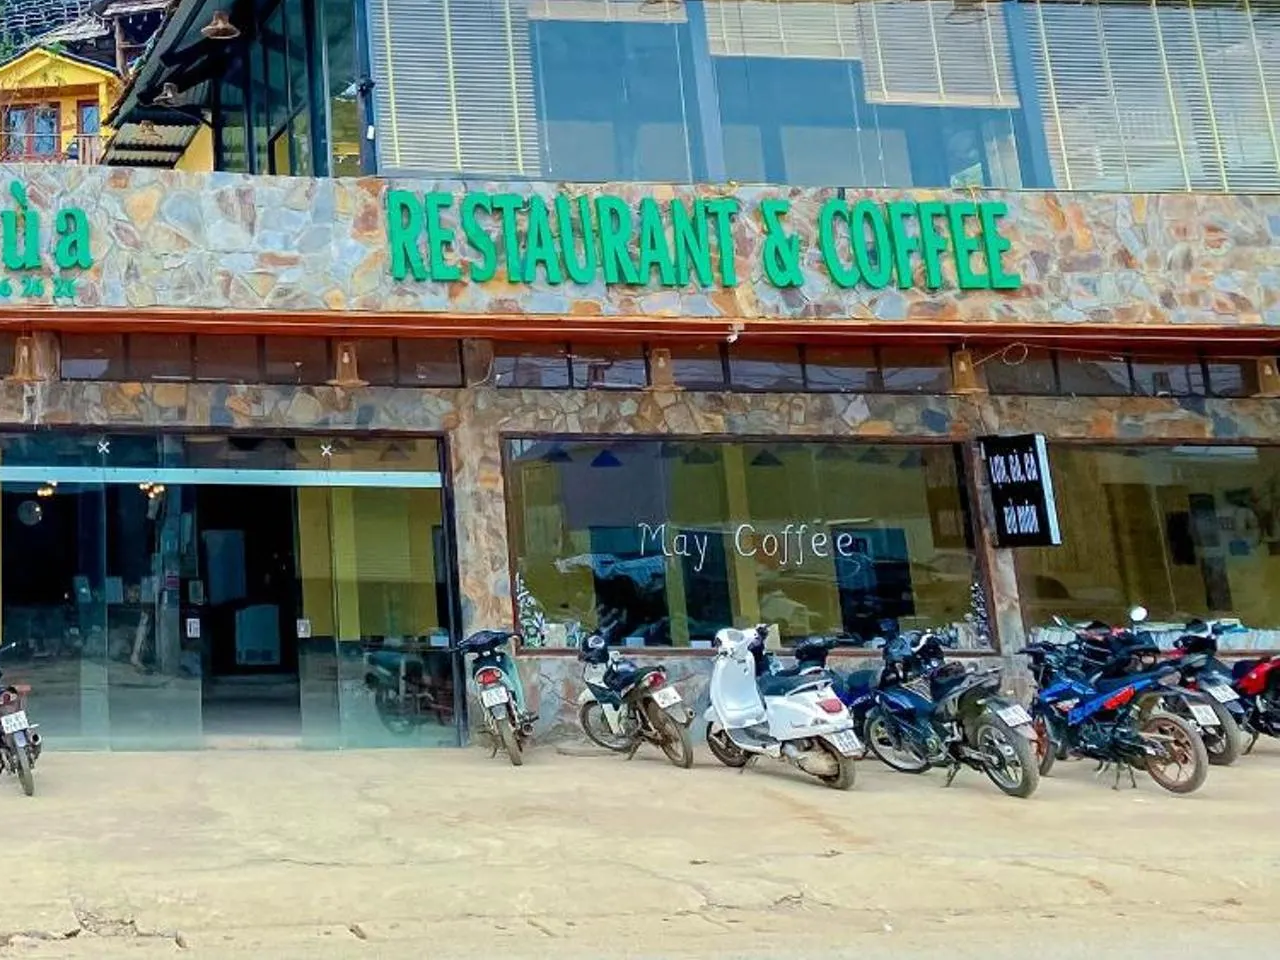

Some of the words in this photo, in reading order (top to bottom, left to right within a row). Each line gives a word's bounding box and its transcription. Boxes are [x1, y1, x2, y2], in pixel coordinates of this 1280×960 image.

[387, 190, 738, 287] RESTAURANT
[760, 199, 803, 289] &
[816, 198, 1021, 290] COFFEE
[637, 522, 708, 573] May
[735, 523, 854, 566] Coffee
